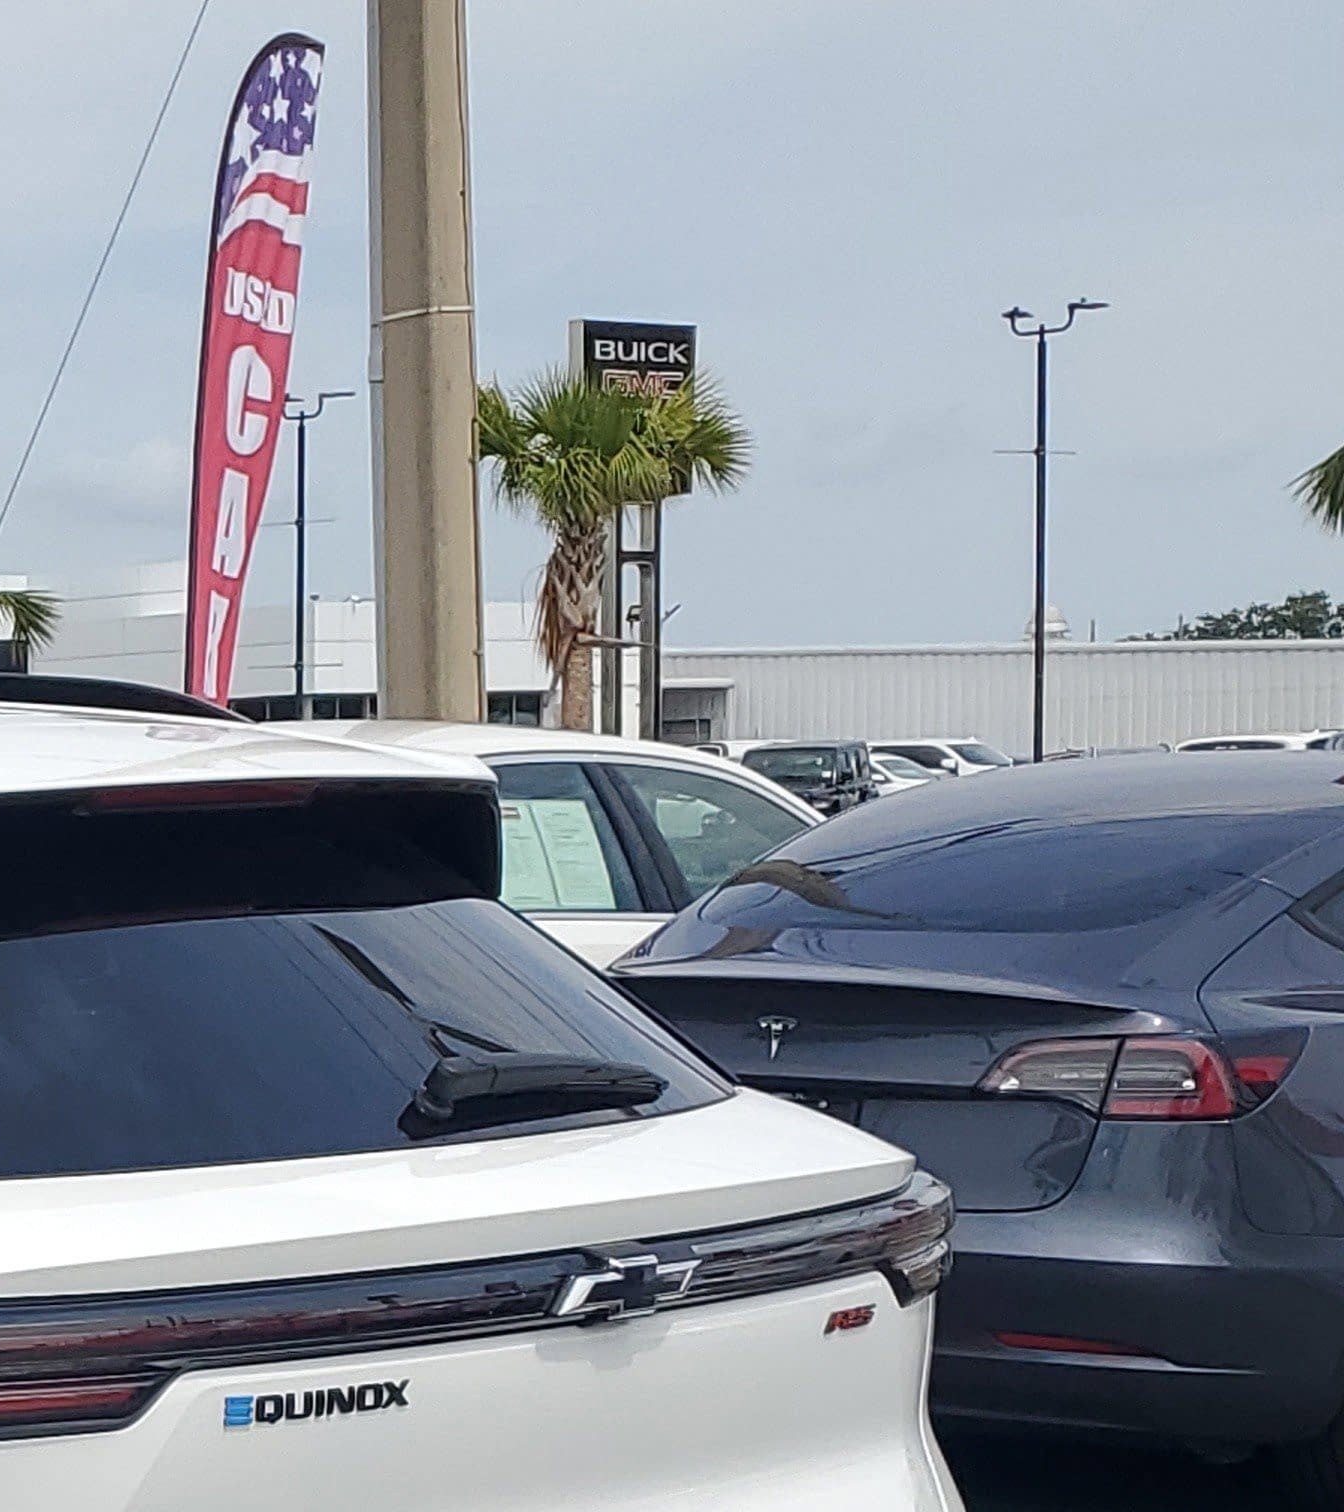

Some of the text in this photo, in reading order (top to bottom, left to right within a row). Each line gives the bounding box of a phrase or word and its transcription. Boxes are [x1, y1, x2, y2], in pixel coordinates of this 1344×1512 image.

[594, 339, 690, 364] BUICK
[824, 1303, 876, 1335] RS
[224, 1379, 410, 1426] EQUINOX
